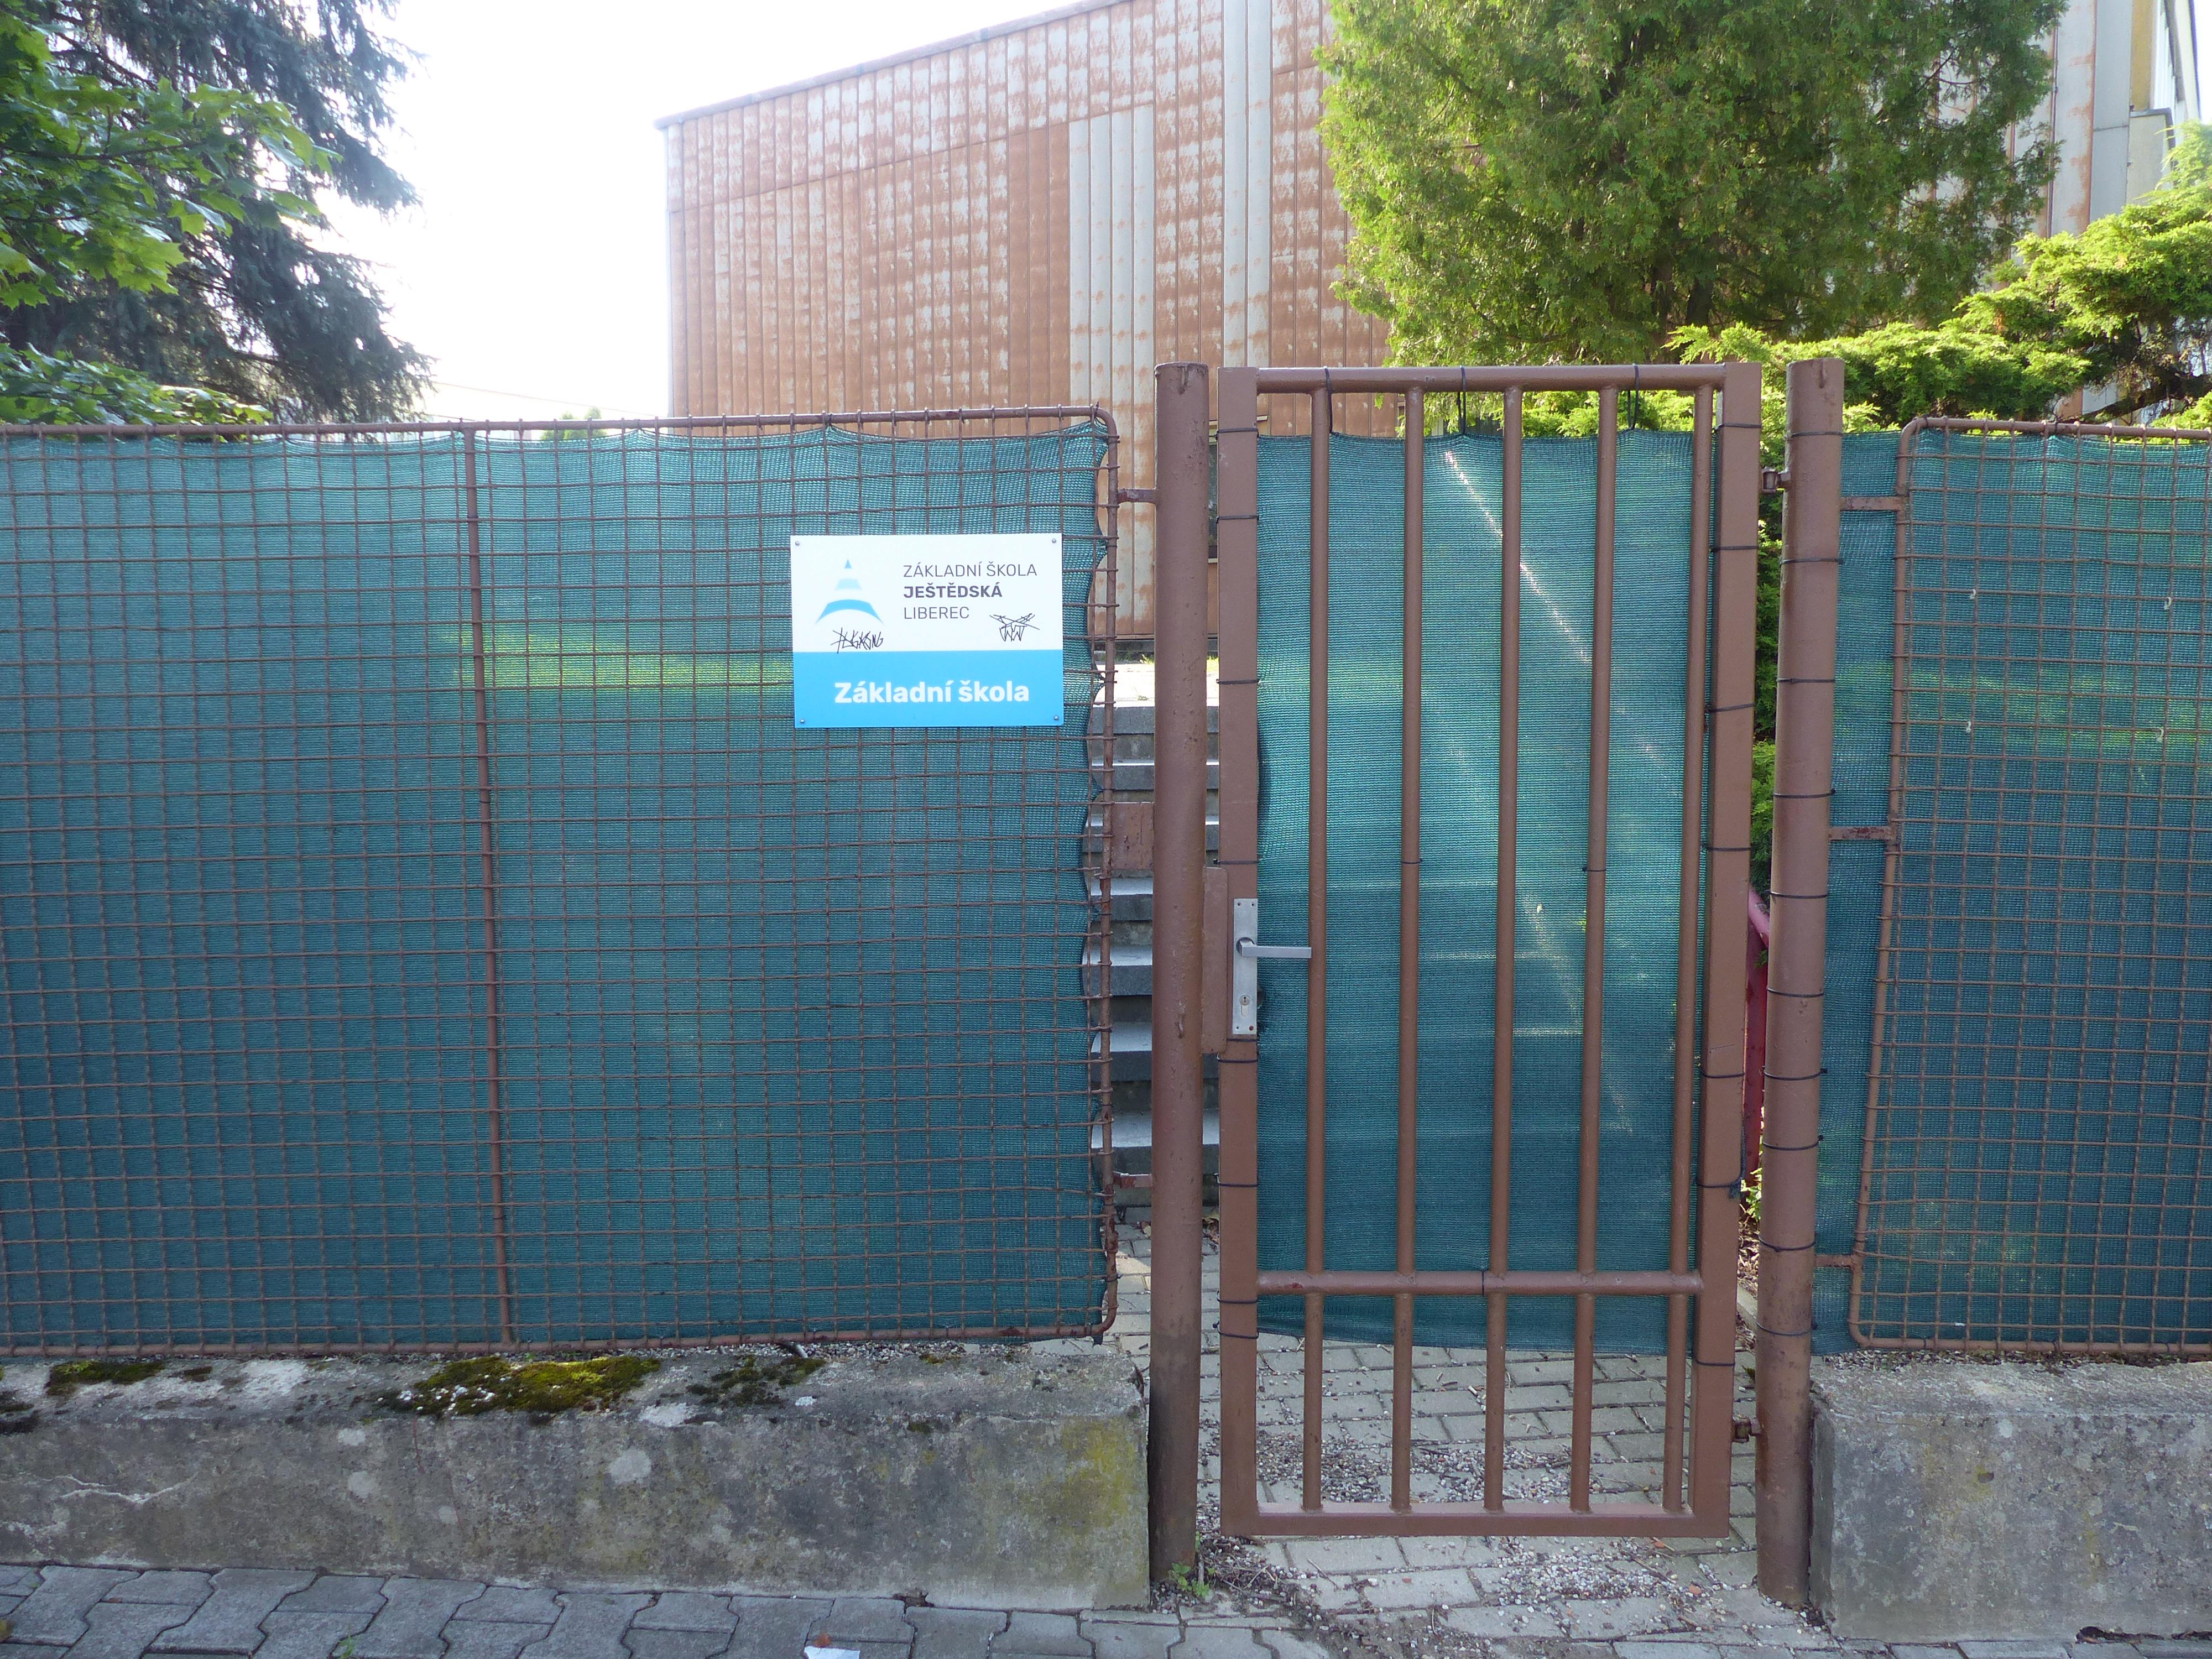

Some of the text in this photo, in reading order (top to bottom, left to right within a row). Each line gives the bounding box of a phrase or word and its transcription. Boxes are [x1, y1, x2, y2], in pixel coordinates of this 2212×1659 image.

[903, 561, 1037, 577] ZÁKLADNÍ ŠKOLA
[903, 582, 1003, 598] JEŠTĚDSKÁ
[904, 606, 969, 619] LIBEREC
[834, 680, 1029, 703] Základní škola
